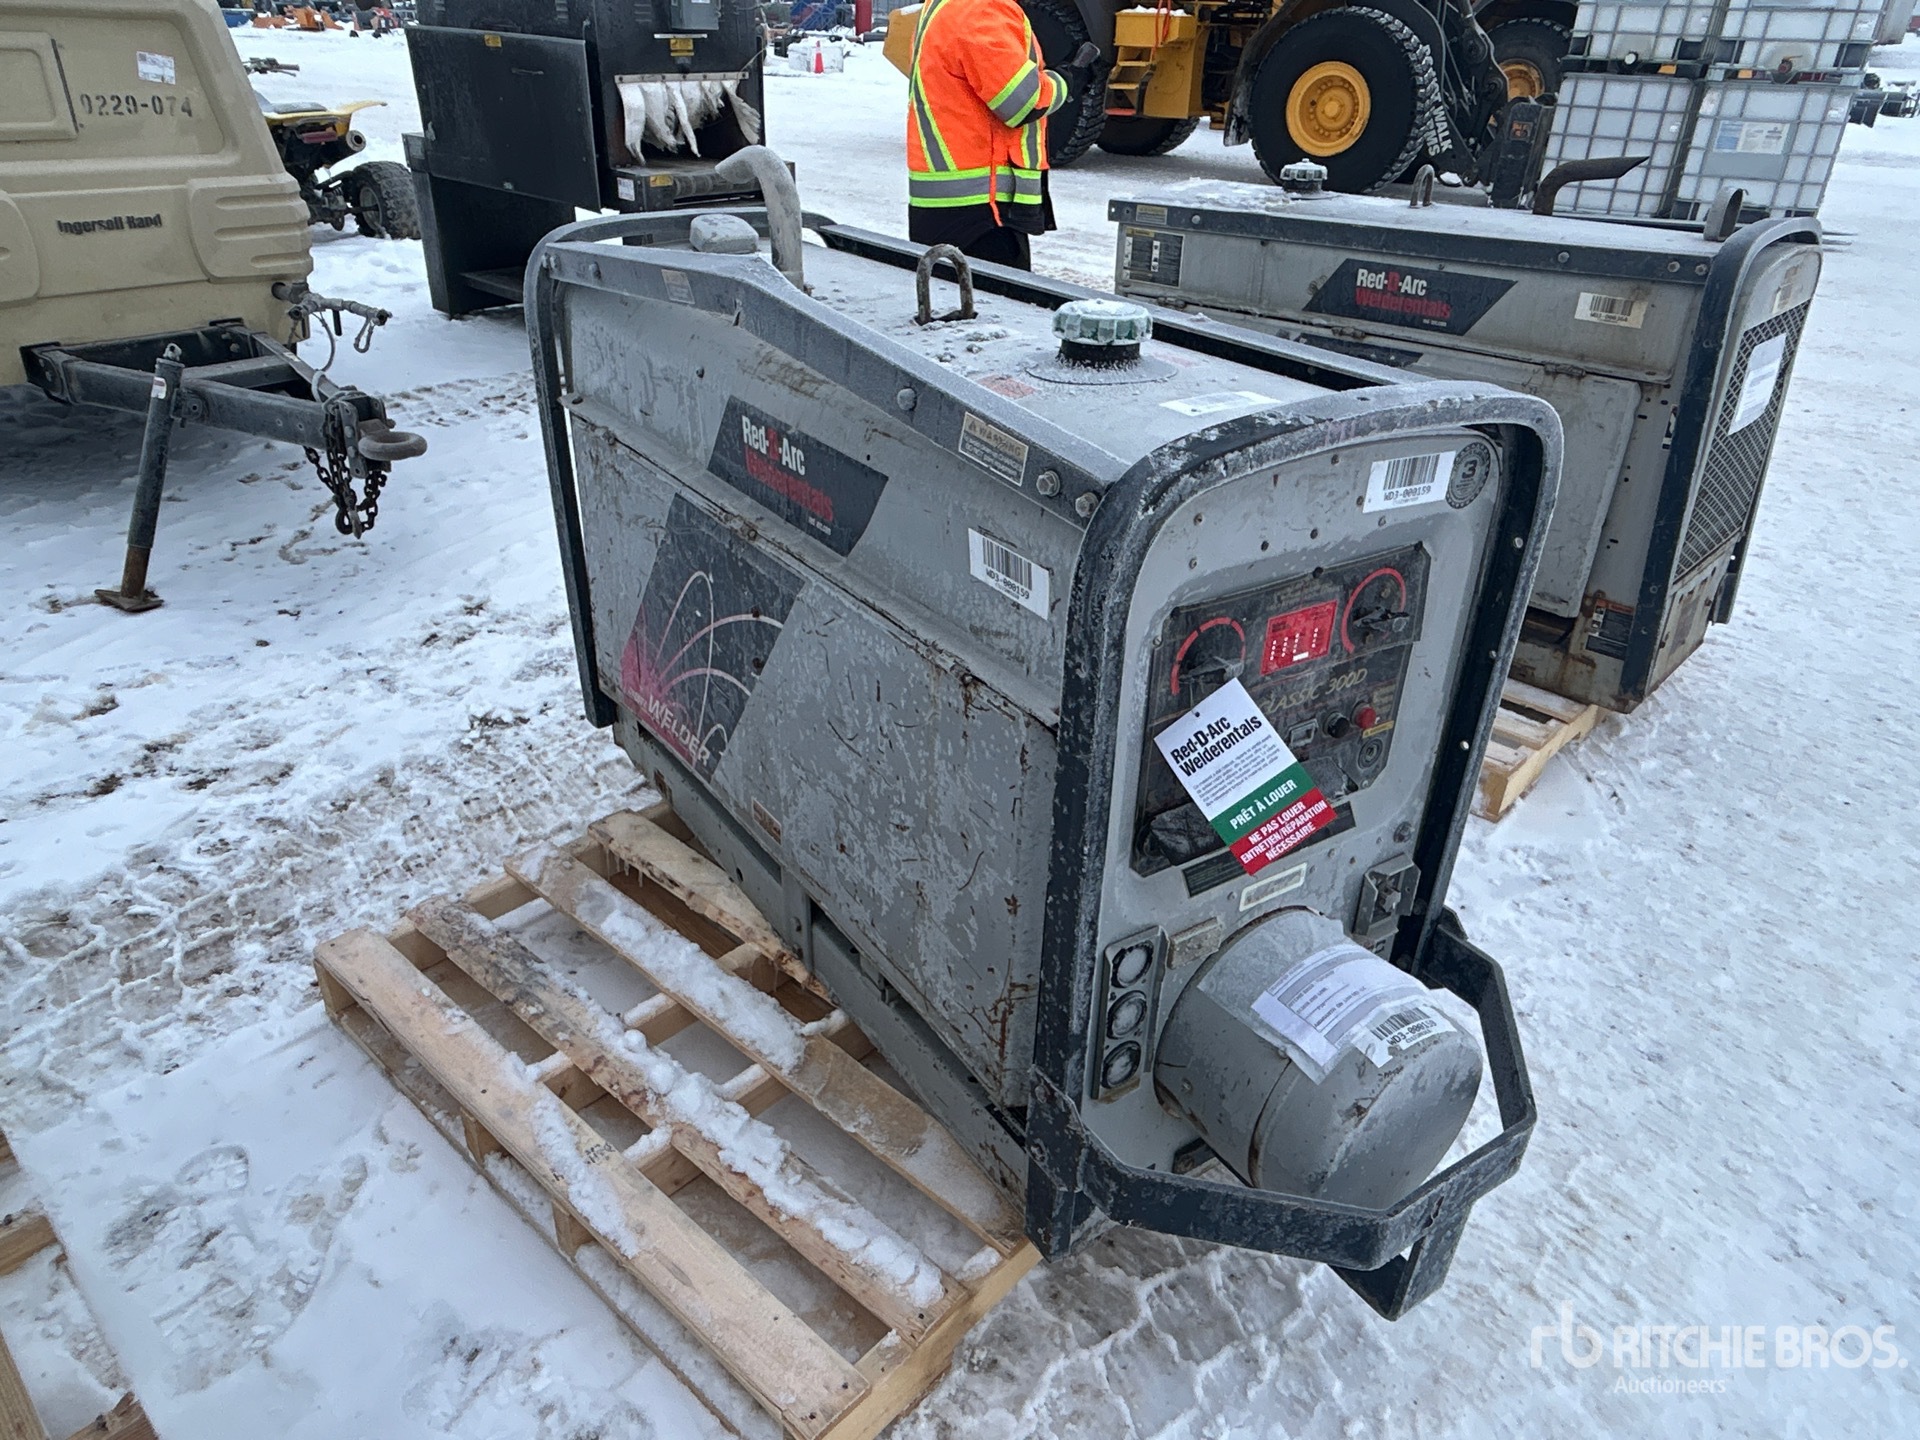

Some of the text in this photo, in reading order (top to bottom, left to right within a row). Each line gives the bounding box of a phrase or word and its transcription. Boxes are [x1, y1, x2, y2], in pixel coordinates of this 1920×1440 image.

[57, 213, 162, 235] Ingersoll Rand
[1462, 460, 1477, 479] 3
[1384, 485, 1431, 501] WD3-000159
[986, 567, 1030, 600] WD3-000159
[648, 693, 711, 766] WELDER
[1179, 716, 1262, 777] Welderentals
[1229, 779, 1298, 830] PRÊT À LOUER
[1248, 802, 1307, 844] NE PAS LOUER
[1240, 800, 1327, 864] ENTRETIEN/RÉPARATION
[1265, 821, 1316, 861] NÉCESSAIRE
